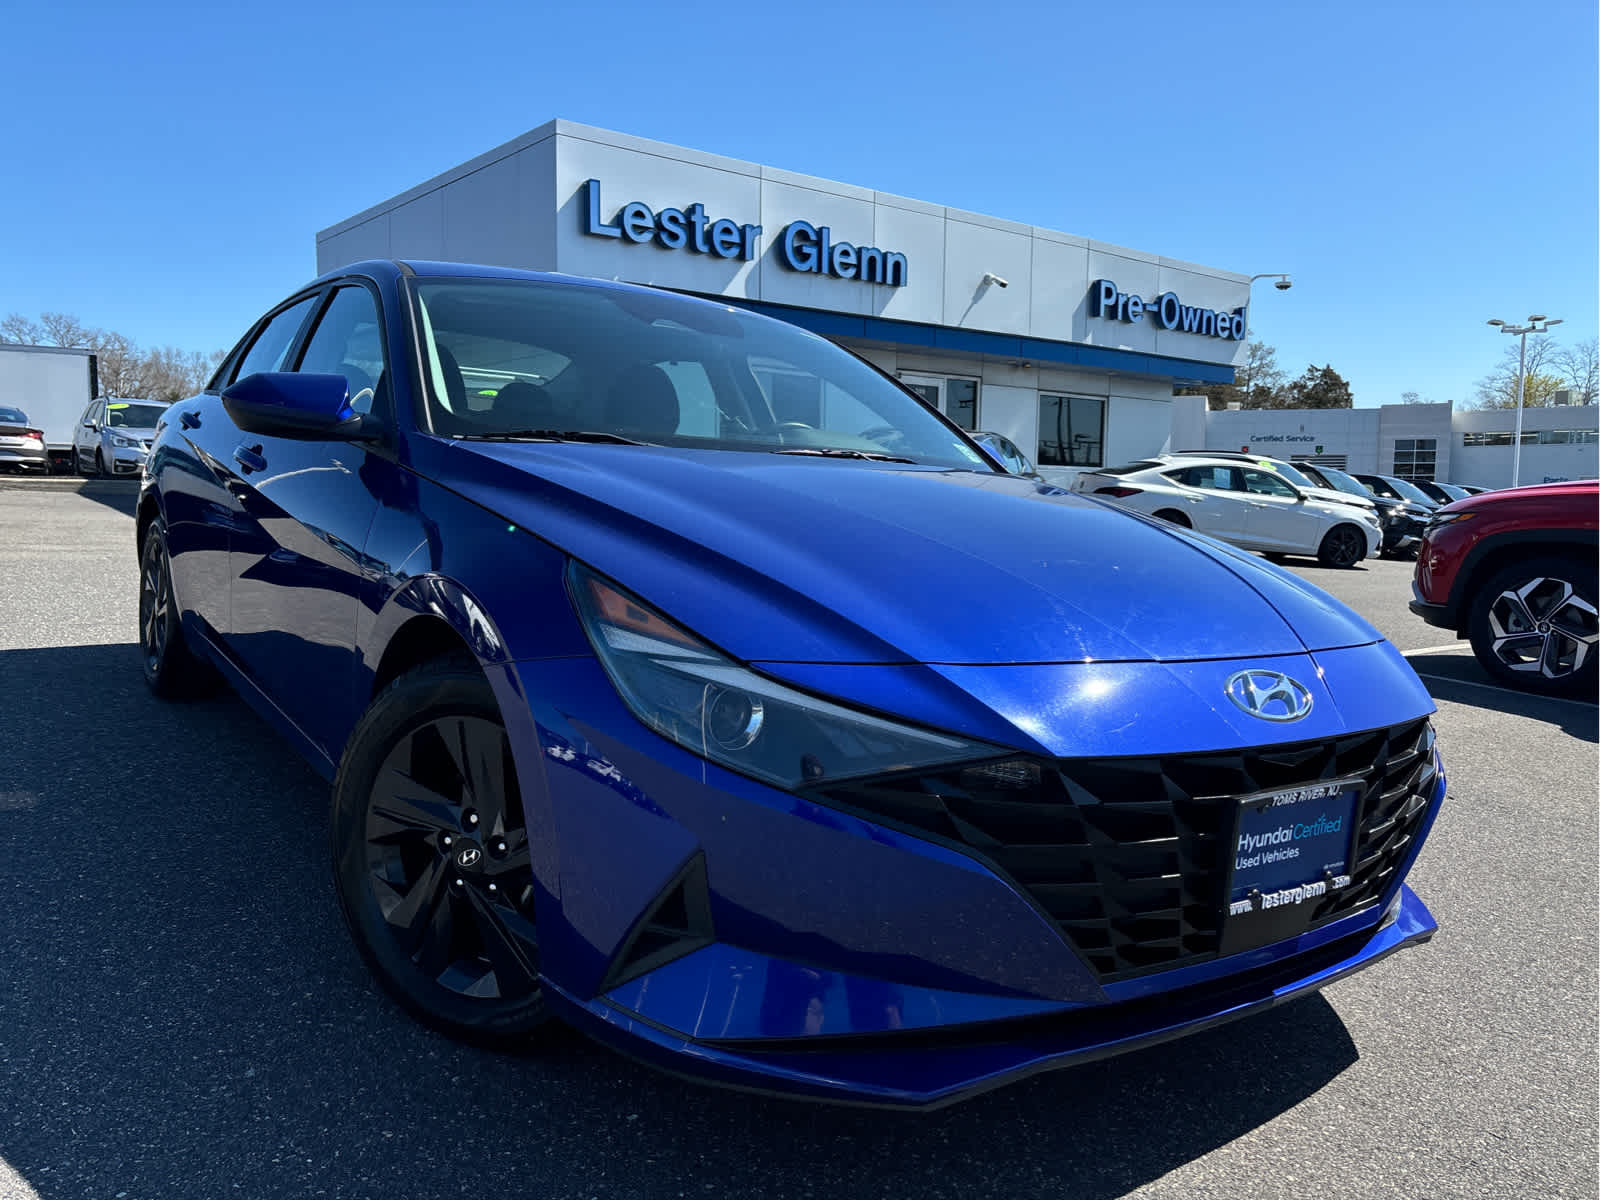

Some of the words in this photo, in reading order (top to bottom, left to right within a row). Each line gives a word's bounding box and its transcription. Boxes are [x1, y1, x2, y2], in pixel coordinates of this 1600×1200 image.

[585, 178, 762, 261] Lester
[782, 219, 908, 288] Glenn
[1092, 279, 1247, 341] Pre-Owned
[1272, 792, 1299, 807] TOMS
[1237, 825, 1293, 852] Hyundai
[1293, 814, 1342, 839] Certified
[1235, 855, 1261, 870] Used
[1262, 847, 1300, 865] Vehicles
[1261, 881, 1326, 909] lesterglenn
